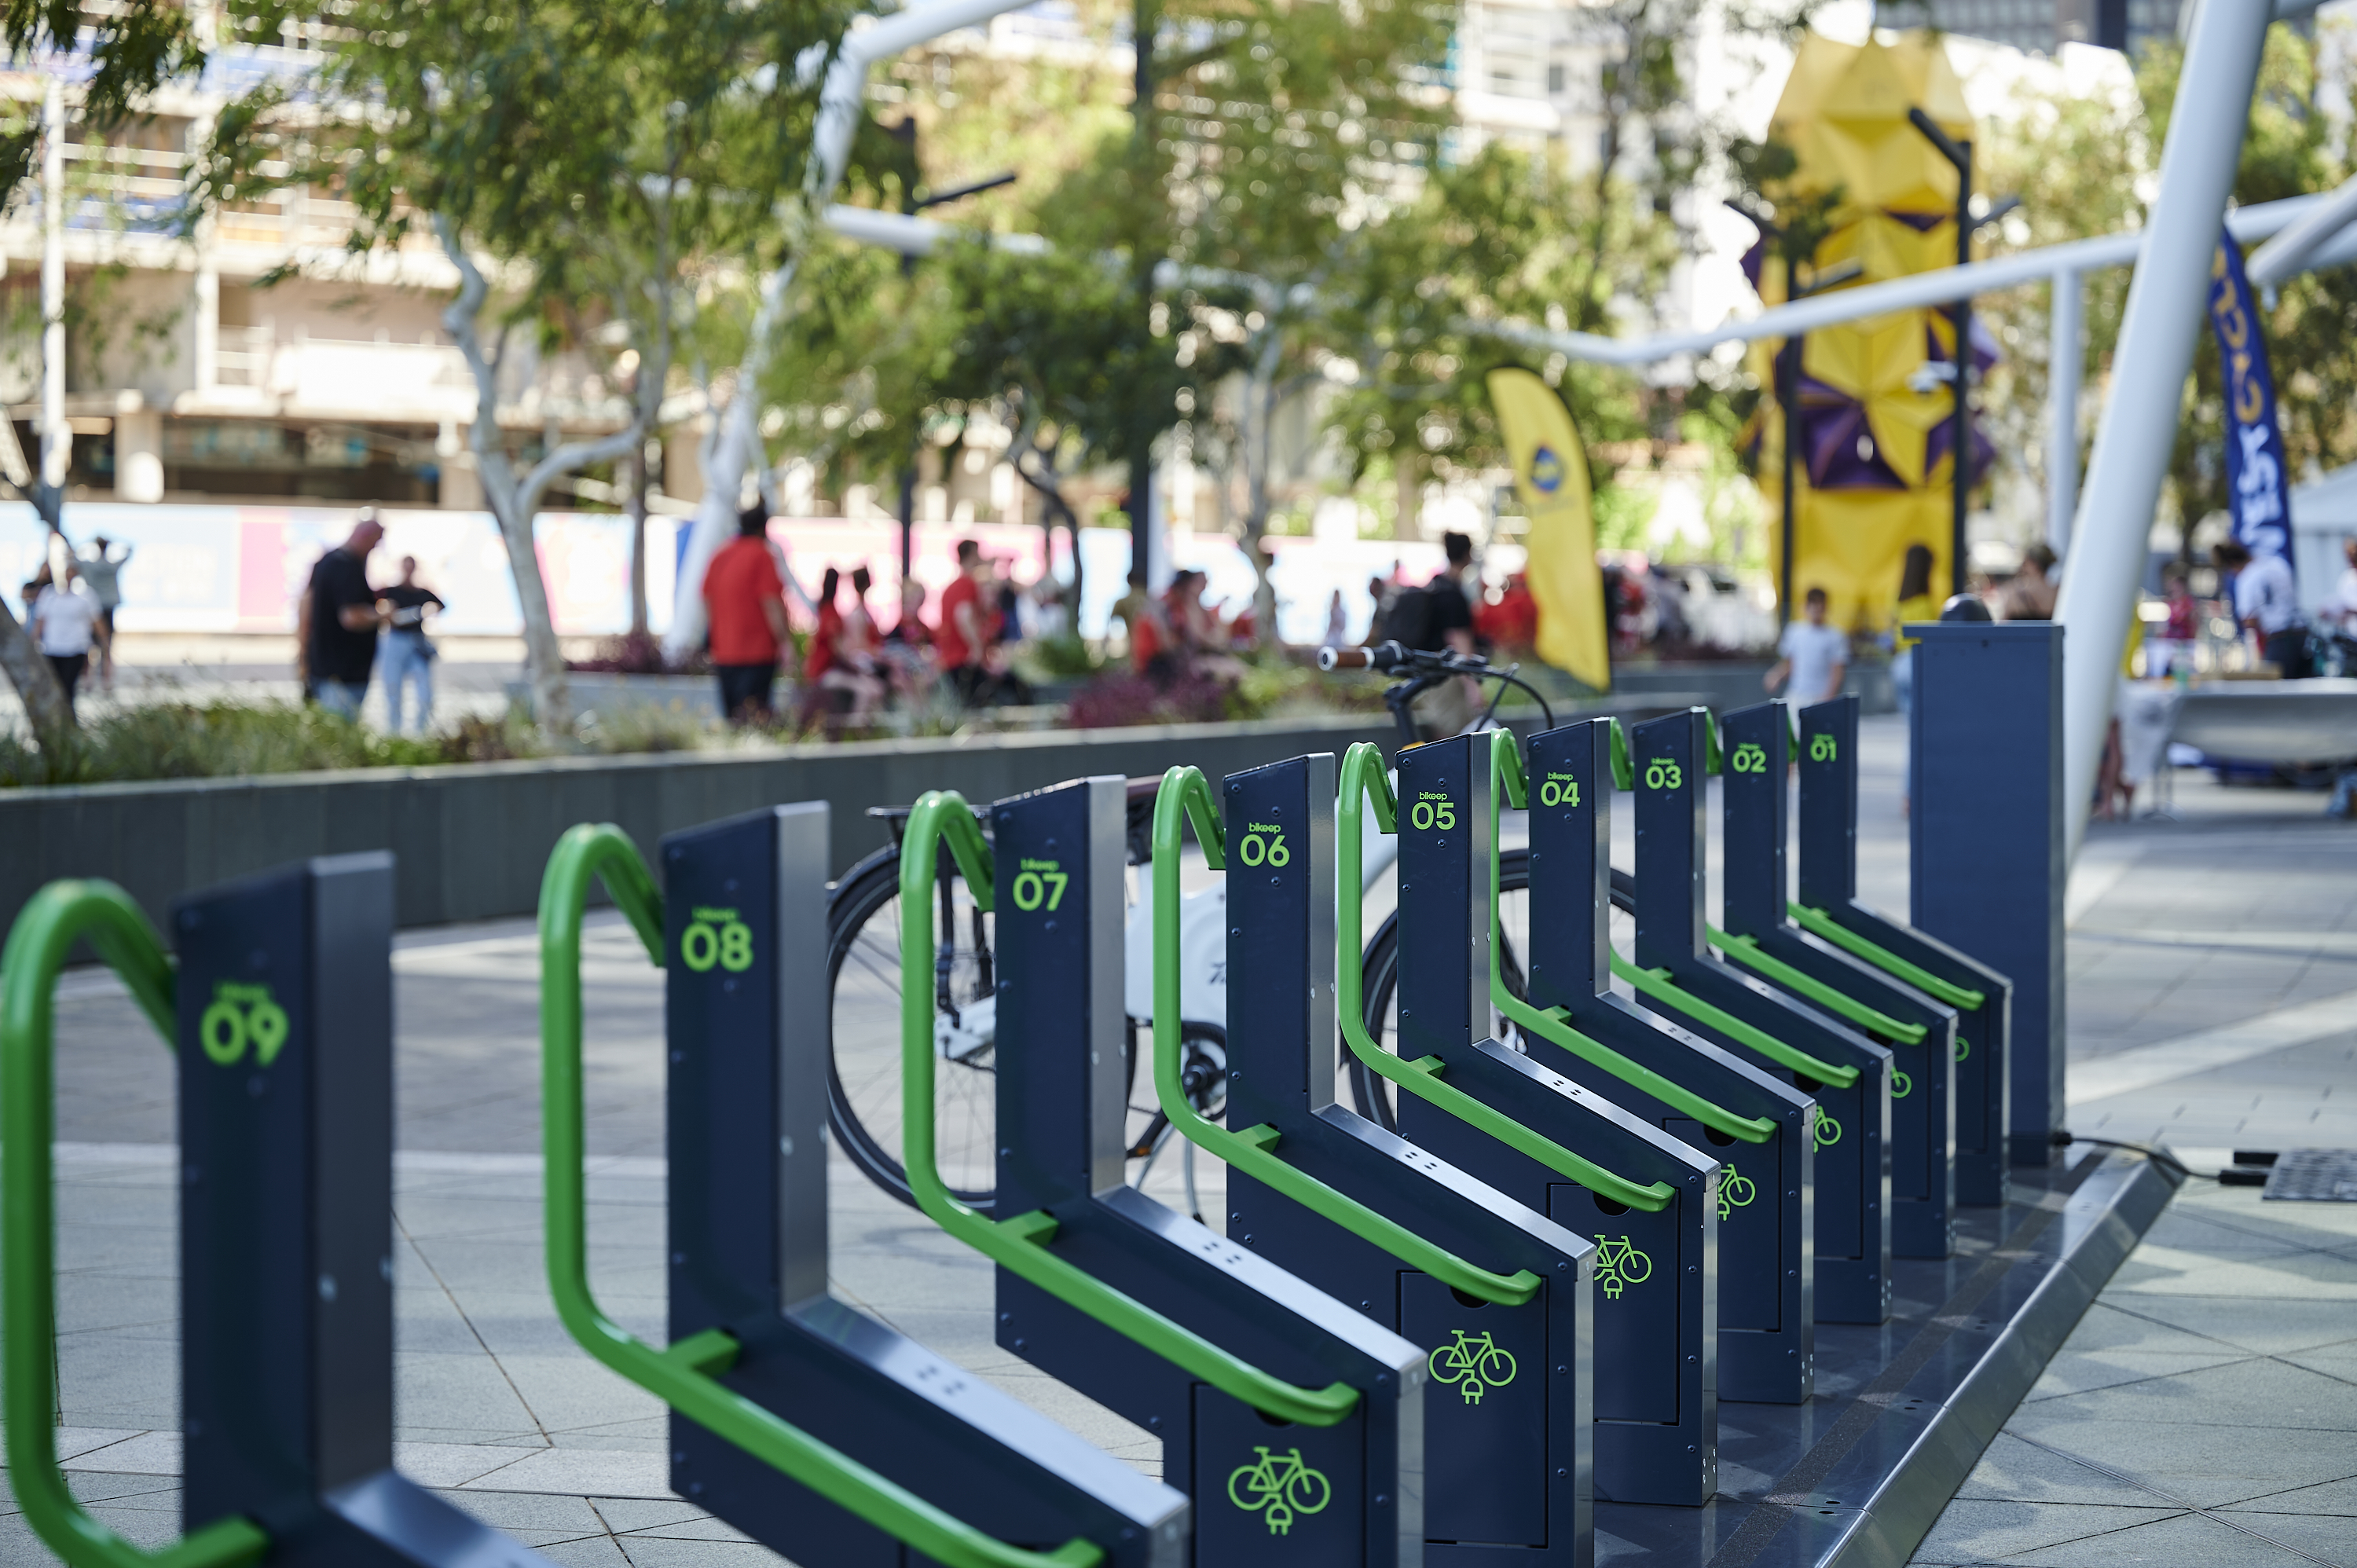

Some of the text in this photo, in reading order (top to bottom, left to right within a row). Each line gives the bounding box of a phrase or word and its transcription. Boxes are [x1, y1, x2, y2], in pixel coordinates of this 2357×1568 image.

[1732, 749, 1767, 773] 02
[1810, 740, 1837, 762] 01
[1547, 772, 1574, 782] bikeep
[1645, 765, 1682, 789] 03
[1419, 792, 1447, 801] bikeep
[1540, 781, 1581, 808] 04
[1248, 822, 1281, 833] bikeep
[1411, 802, 1456, 830] 05
[1240, 834, 1290, 867] 06
[1013, 871, 1069, 911] 07
[681, 921, 754, 973] 08
[200, 999, 290, 1066] 09
